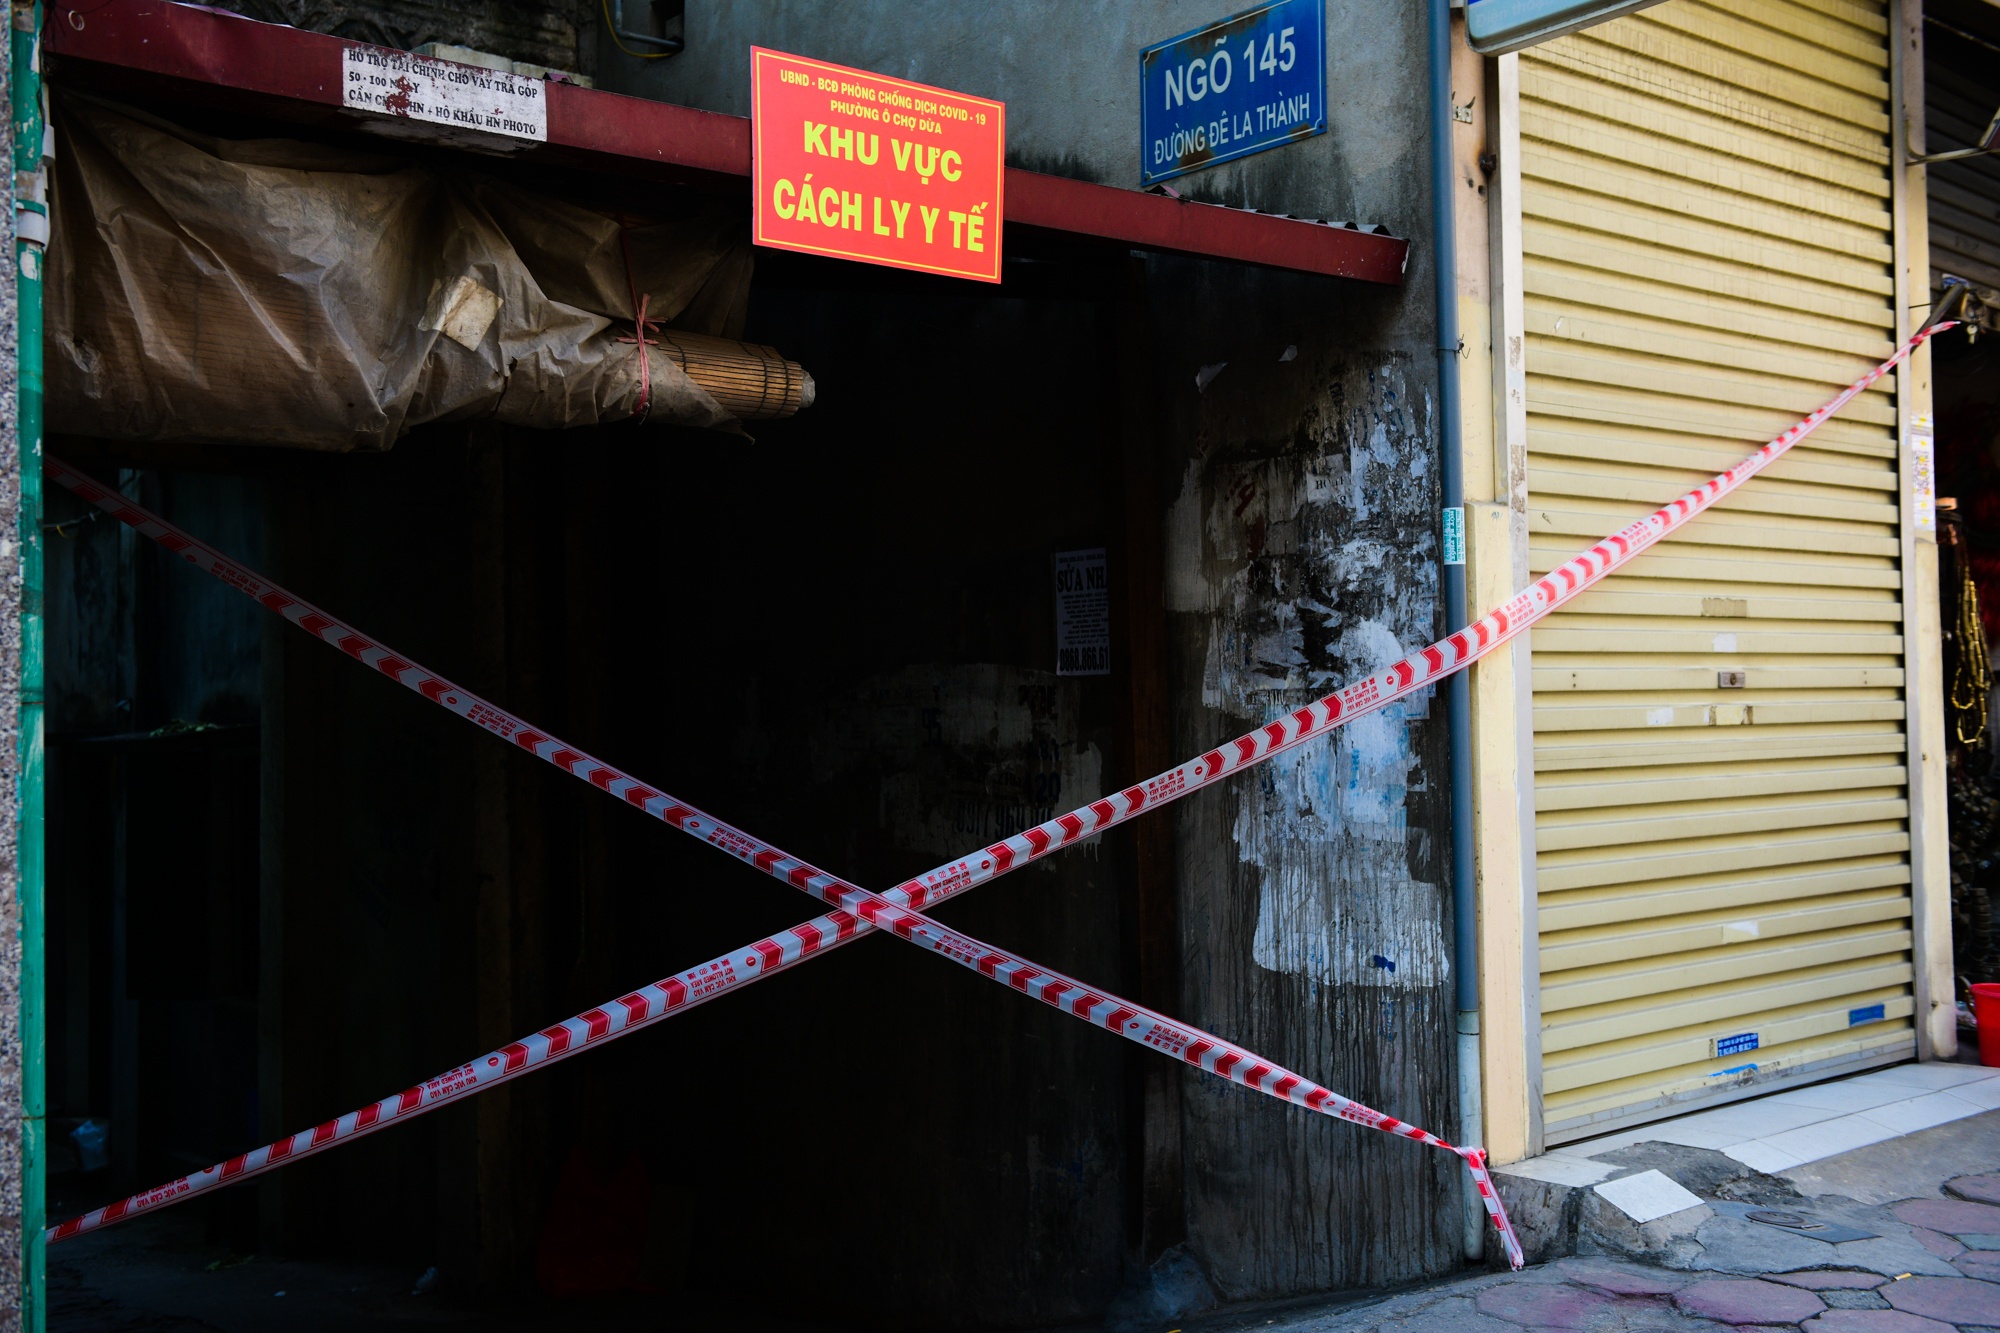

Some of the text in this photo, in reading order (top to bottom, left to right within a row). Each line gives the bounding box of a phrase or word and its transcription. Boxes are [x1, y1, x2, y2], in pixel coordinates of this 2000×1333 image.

[349, 72, 360, 82] 50
[370, 76, 386, 87] 100
[390, 78, 420, 93] NY
[1165, 26, 1296, 110] NGÕ 145
[780, 69, 809, 87] UBND
[818, 77, 838, 93] BCĐ
[841, 82, 876, 102] PHÒNG
[878, 90, 912, 110] CHỐNG
[915, 99, 937, 116] DỊCH
[939, 104, 968, 122] COVID
[975, 113, 986, 126] 19
[830, 100, 942, 134] PHƯỜNG Ô CHỢ DỪA
[503, 119, 536, 134] PHOTO
[804, 120, 962, 185] KHU VỰC
[1155, 91, 1310, 164] ĐƯỜNG ĐÊ LA THÀNH
[773, 173, 989, 252] CÁCH LY Y TẾ
[1057, 564, 1107, 592] SỬA NH
